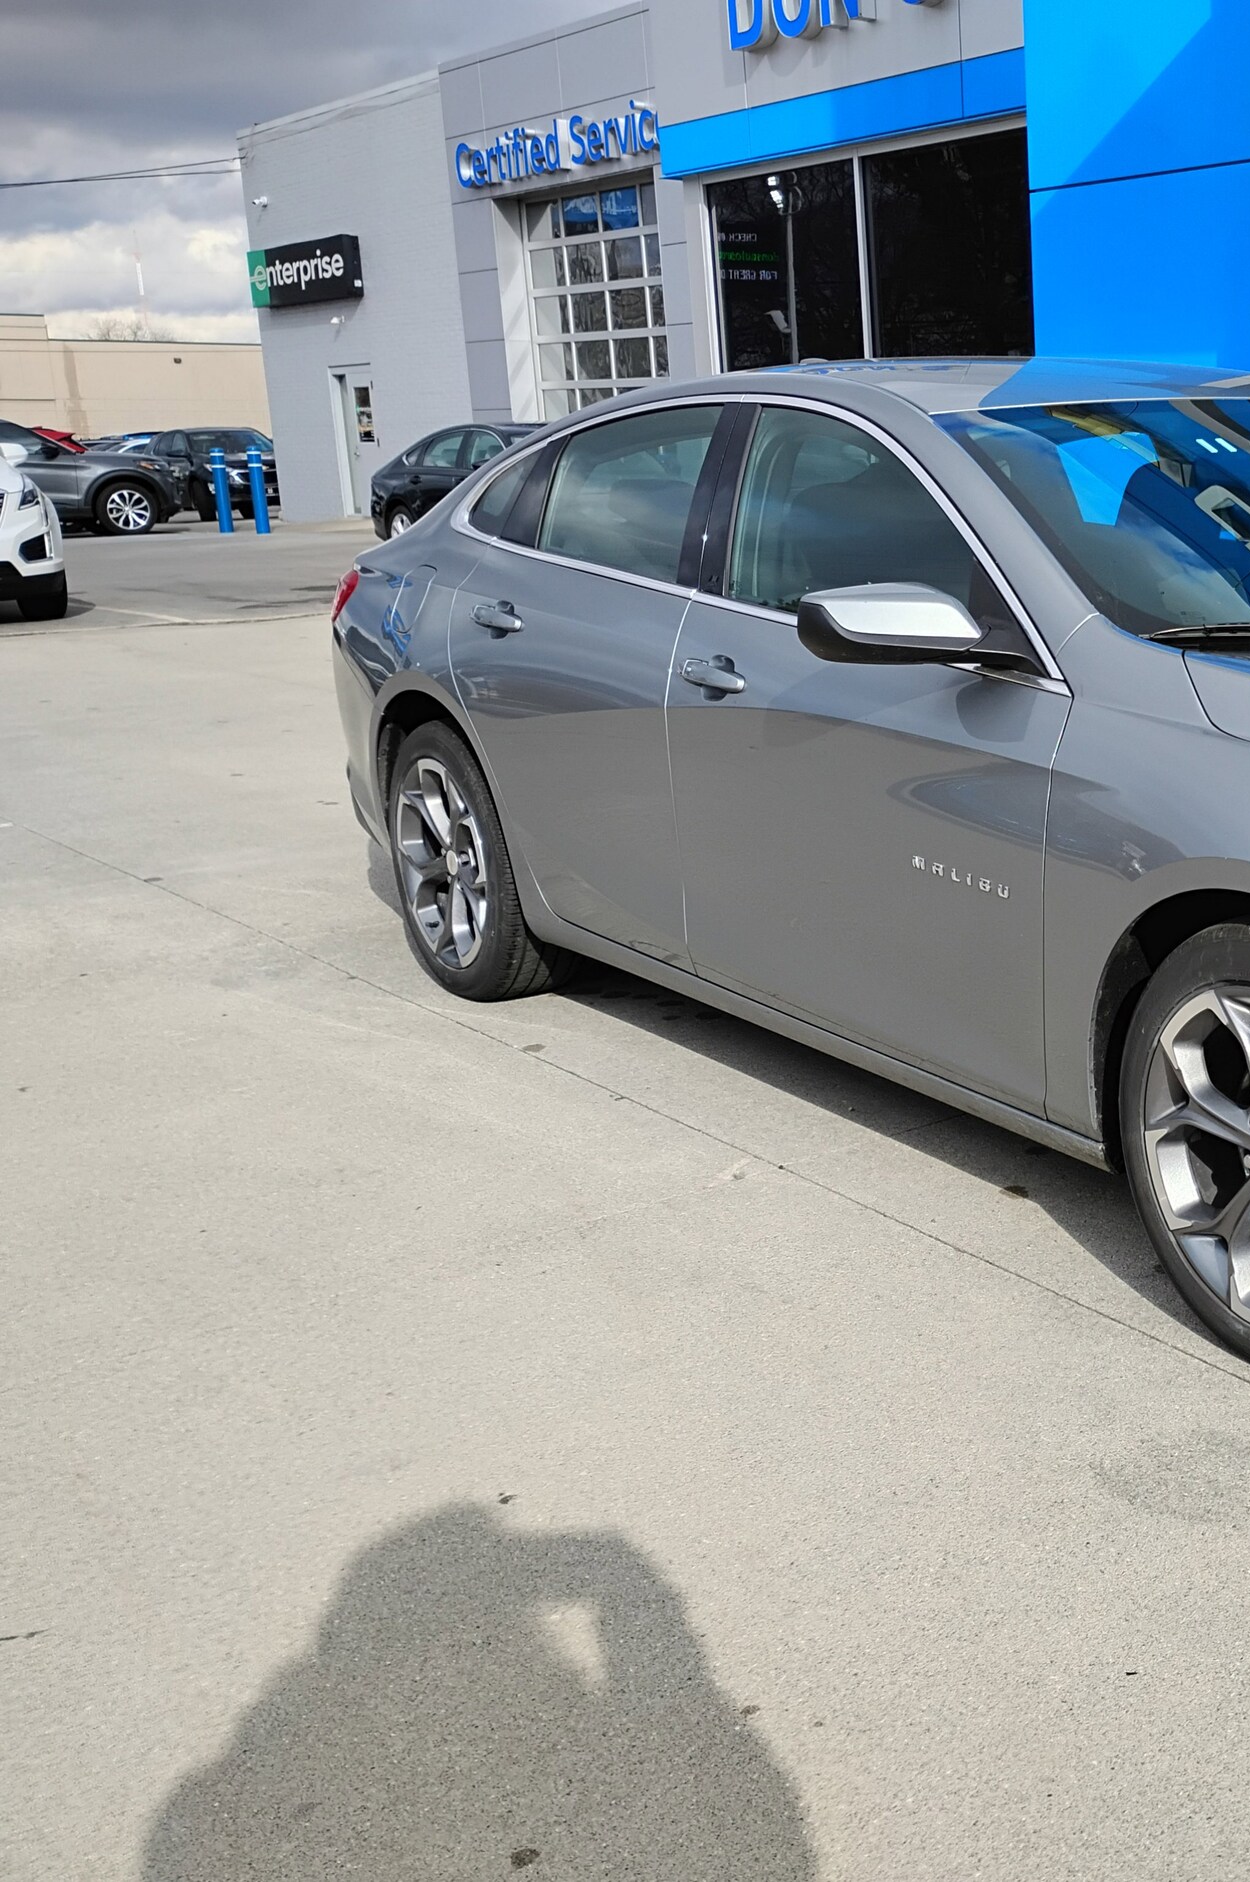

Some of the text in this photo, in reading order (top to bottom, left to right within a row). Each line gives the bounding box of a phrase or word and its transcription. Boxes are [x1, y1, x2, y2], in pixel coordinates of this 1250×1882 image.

[456, 100, 661, 188] Certified Servic
[249, 249, 344, 290] enterprise
[911, 855, 1010, 899] MALIBU
